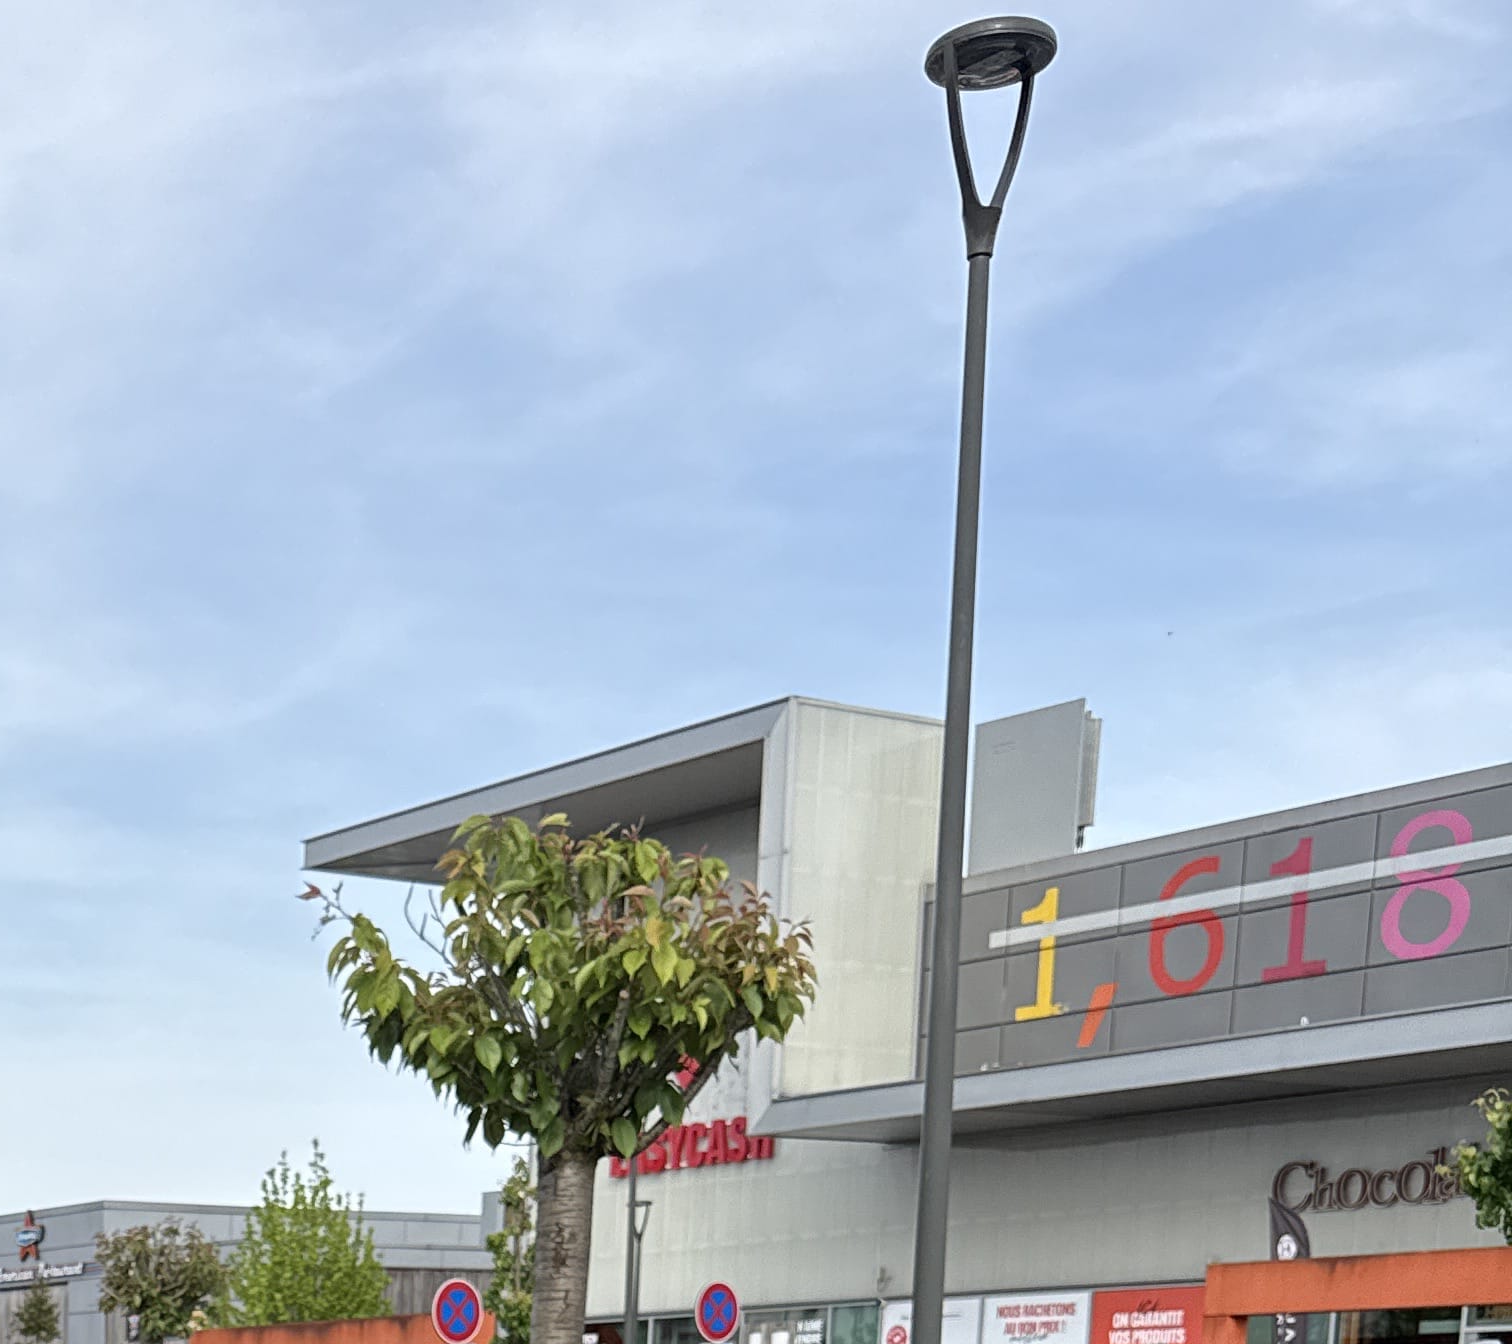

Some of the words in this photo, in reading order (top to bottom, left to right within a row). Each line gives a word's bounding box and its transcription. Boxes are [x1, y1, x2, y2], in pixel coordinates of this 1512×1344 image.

[1014, 809, 1473, 1049] 1,618
[1272, 1147, 1467, 1215] Chocola
[1132, 1327, 1187, 1344] PRODUITS
